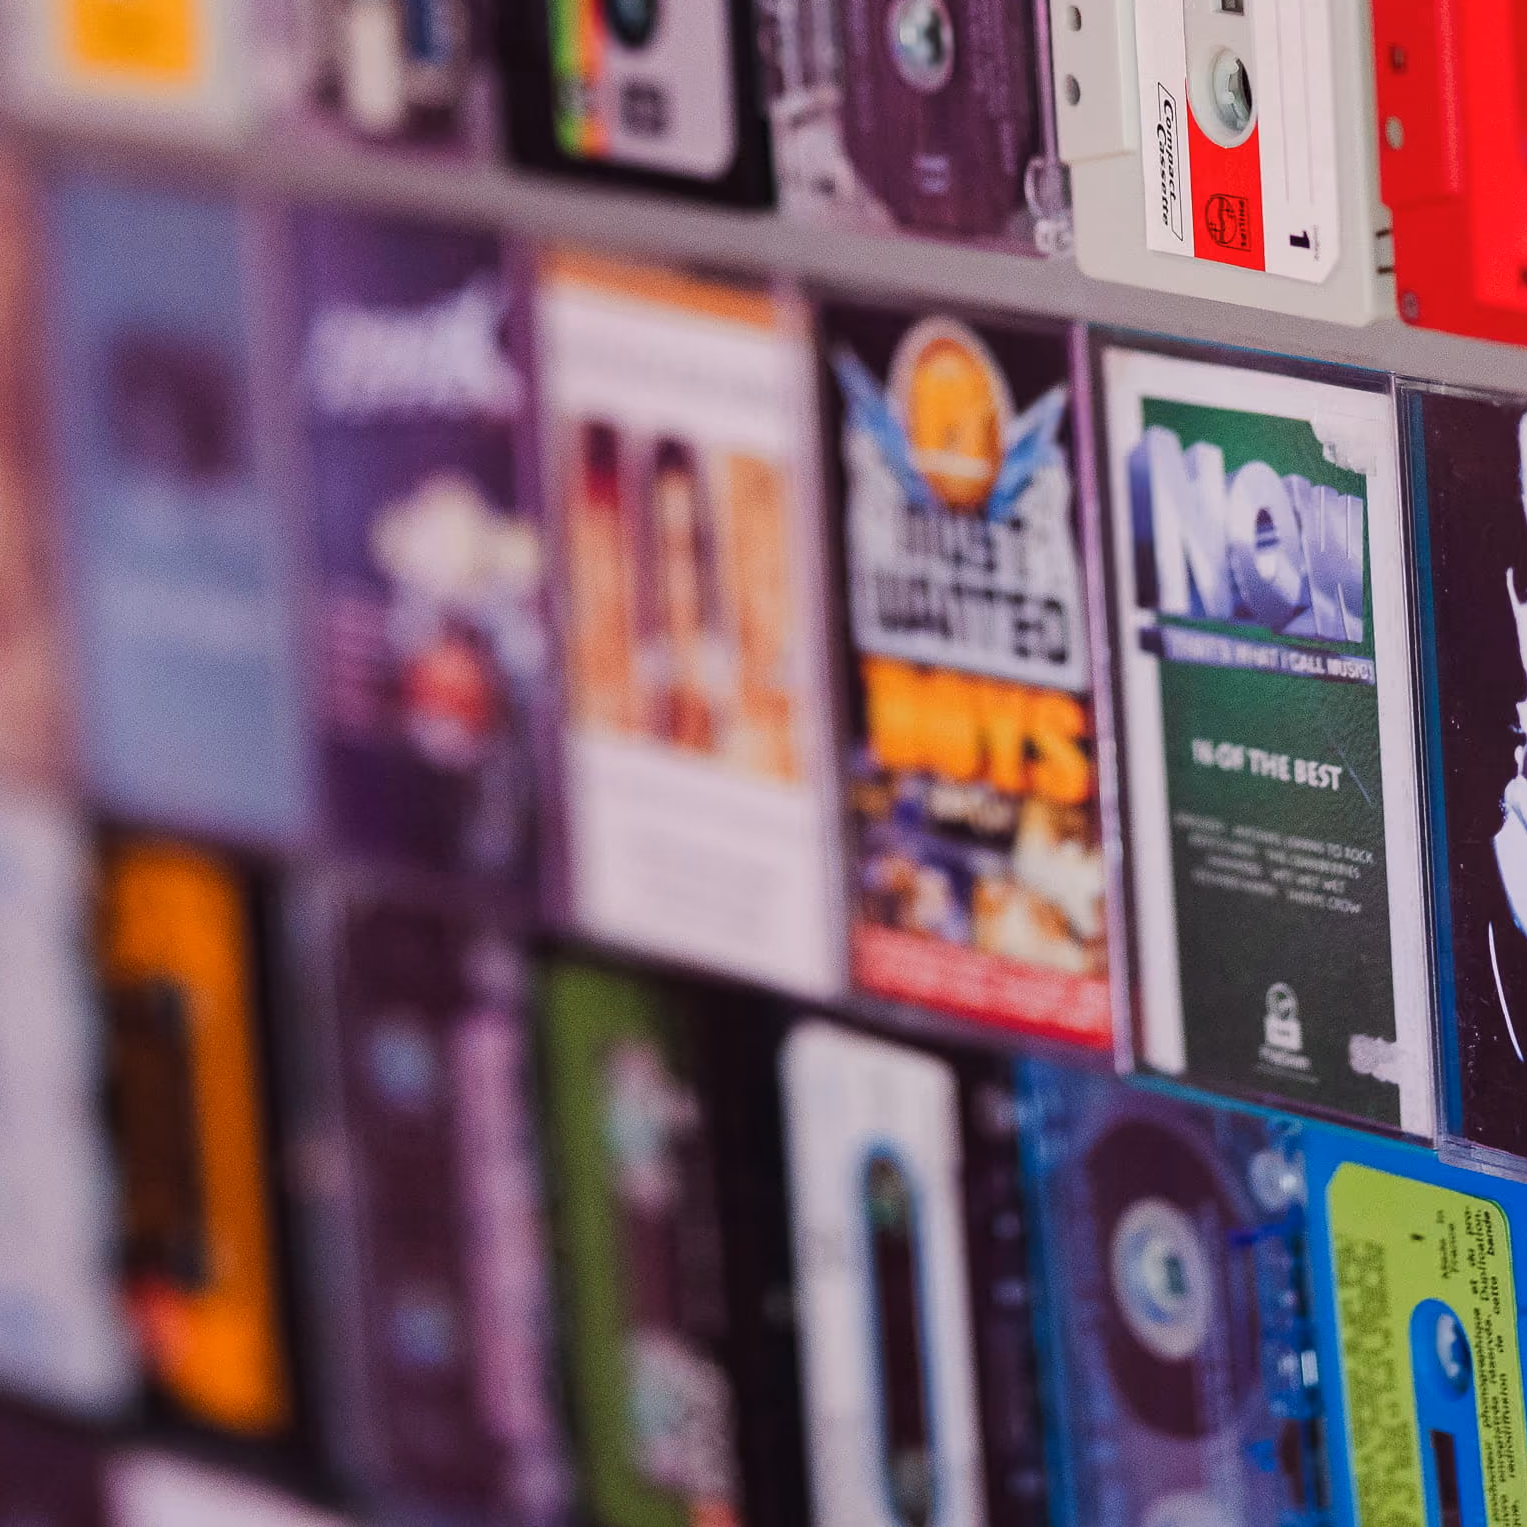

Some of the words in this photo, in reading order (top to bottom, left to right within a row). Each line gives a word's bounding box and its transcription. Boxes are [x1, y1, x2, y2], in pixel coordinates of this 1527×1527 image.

[1163, 98, 1177, 202] Compact
[1156, 122, 1170, 227] Cassette
[1238, 200, 1247, 249] PHILIPS
[1289, 230, 1311, 250] 1
[1129, 424, 1365, 644] NOW
[1289, 652, 1324, 675] CALL
[1248, 747, 1292, 782] THE
[1294, 757, 1343, 791] BEST
[1482, 1211, 1496, 1256] bande
